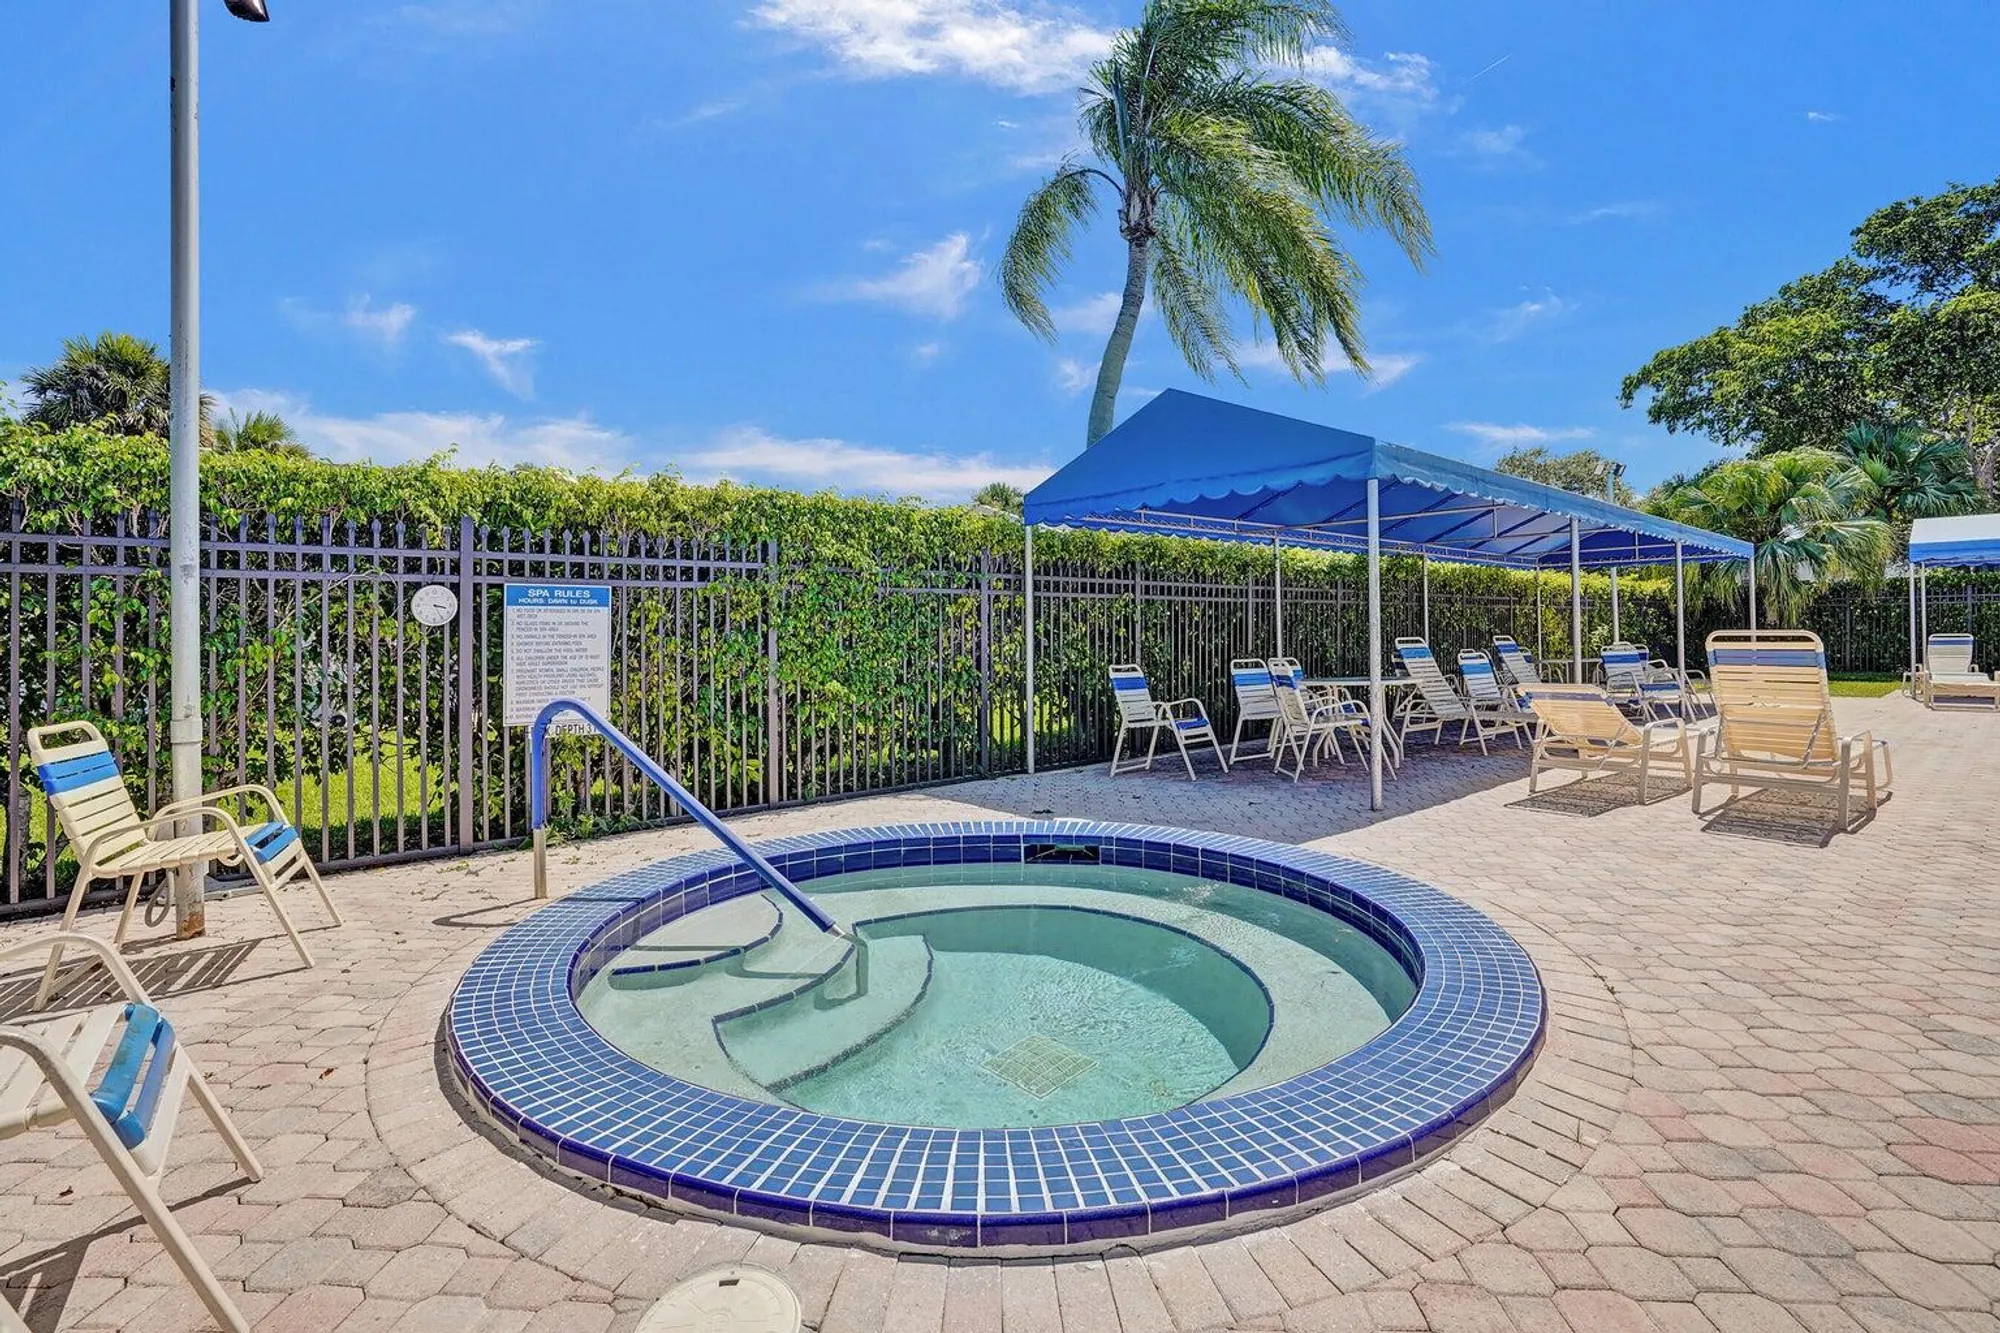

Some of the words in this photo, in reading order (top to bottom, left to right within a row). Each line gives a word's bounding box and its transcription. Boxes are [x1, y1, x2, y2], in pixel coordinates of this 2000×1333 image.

[528, 588, 550, 598] SPA
[555, 589, 591, 599] RULES
[518, 597, 546, 605] HOURS:
